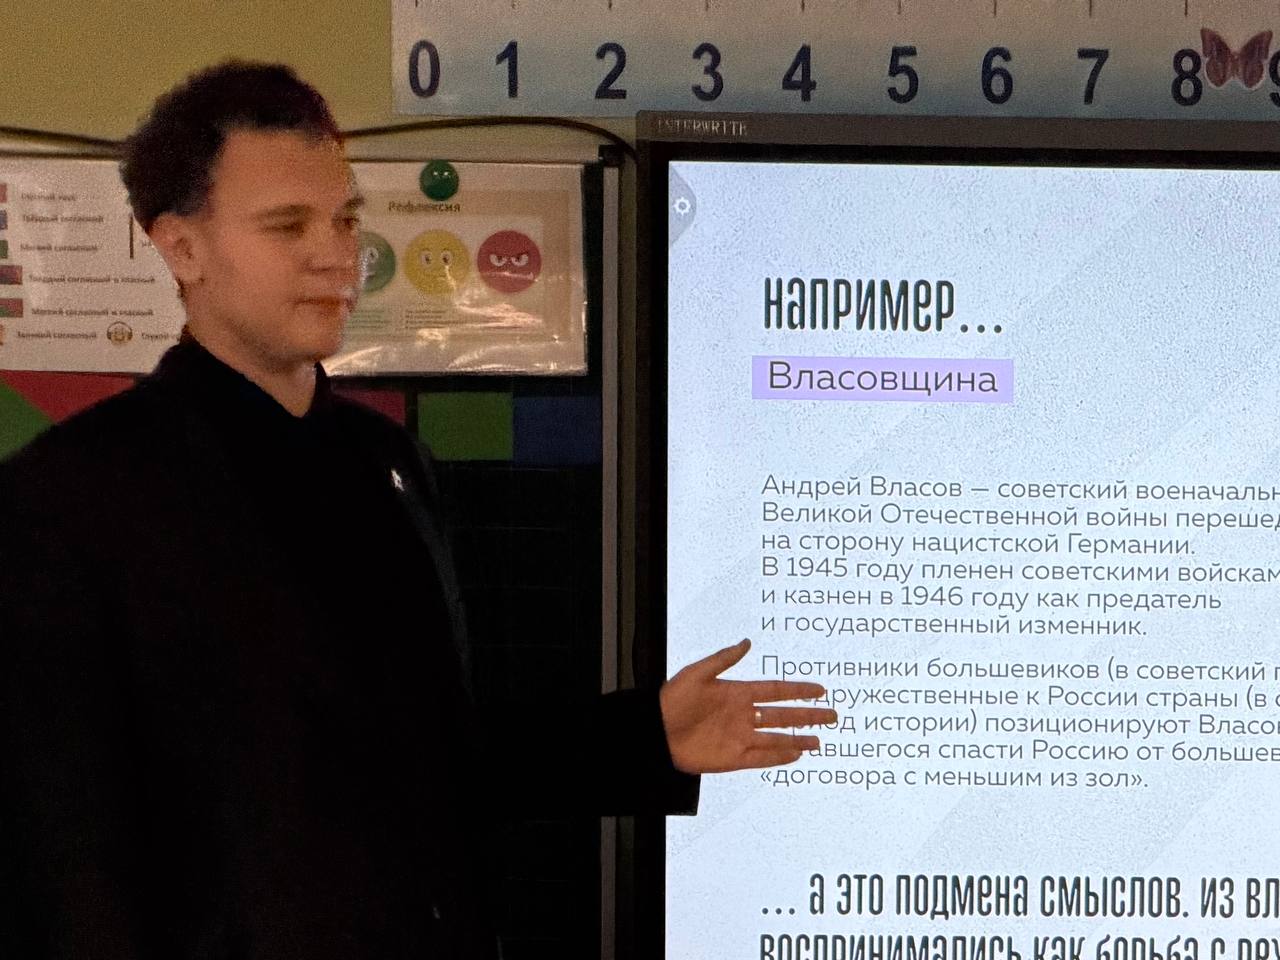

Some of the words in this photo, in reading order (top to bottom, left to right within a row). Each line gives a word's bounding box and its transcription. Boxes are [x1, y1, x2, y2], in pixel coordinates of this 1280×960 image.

[408, 39, 441, 99] 0
[495, 40, 519, 99] 1
[594, 41, 627, 100] 2
[691, 42, 724, 102] 3
[781, 43, 817, 102] 4
[887, 45, 919, 104] 5
[981, 46, 1014, 105] 6
[1076, 47, 1110, 105] 7
[1171, 48, 1203, 106] 8
[769, 360, 999, 397] Власовщина
[761, 474, 861, 501] Андрей
[870, 475, 963, 498] Власов
[997, 481, 1128, 499] советский
[762, 501, 872, 524] Великой
[880, 502, 1078, 526] Отечественной
[1086, 509, 1167, 527] войны
[761, 534, 792, 550] на
[799, 534, 905, 553] сторону
[912, 532, 1059, 555] нацистской
[1068, 532, 1196, 558] Германии.
[762, 556, 779, 577] В
[787, 556, 848, 578] 1945
[856, 562, 914, 582] году
[921, 562, 1014, 580] пленен
[1021, 564, 1169, 582] советскими
[761, 589, 776, 604] и
[784, 589, 872, 605] казнен
[880, 590, 894, 606] в
[901, 585, 964, 607] 1946
[971, 591, 1030, 614] году
[1037, 592, 1080, 608] как
[1087, 592, 1222, 614] предатель
[761, 616, 775, 631] и
[784, 614, 1010, 638] государственный
[1018, 618, 1148, 637] изменник.
[761, 654, 919, 681] Противники
[926, 656, 1100, 679] большевиков
[1107, 656, 1129, 682] (в
[1136, 661, 1266, 681] советский
[1026, 690, 1040, 706] к
[1048, 684, 1138, 707] России
[1145, 691, 1238, 711] страны
[1246, 685, 1268, 711] (в
[864, 708, 978, 735] истории)
[985, 717, 1191, 740] позиционируют
[938, 743, 1023, 760] спасти
[1032, 738, 1129, 761] Россию
[1136, 745, 1165, 761] от
[759, 769, 897, 791] «договора
[903, 770, 917, 786] с
[924, 770, 1042, 787] меньшим
[1050, 771, 1078, 788] из
[1085, 771, 1149, 788] зол».
[809, 872, 825, 916] а
[836, 873, 884, 916] это
[895, 873, 1029, 921] подмена
[1039, 875, 1190, 919] смыслов.
